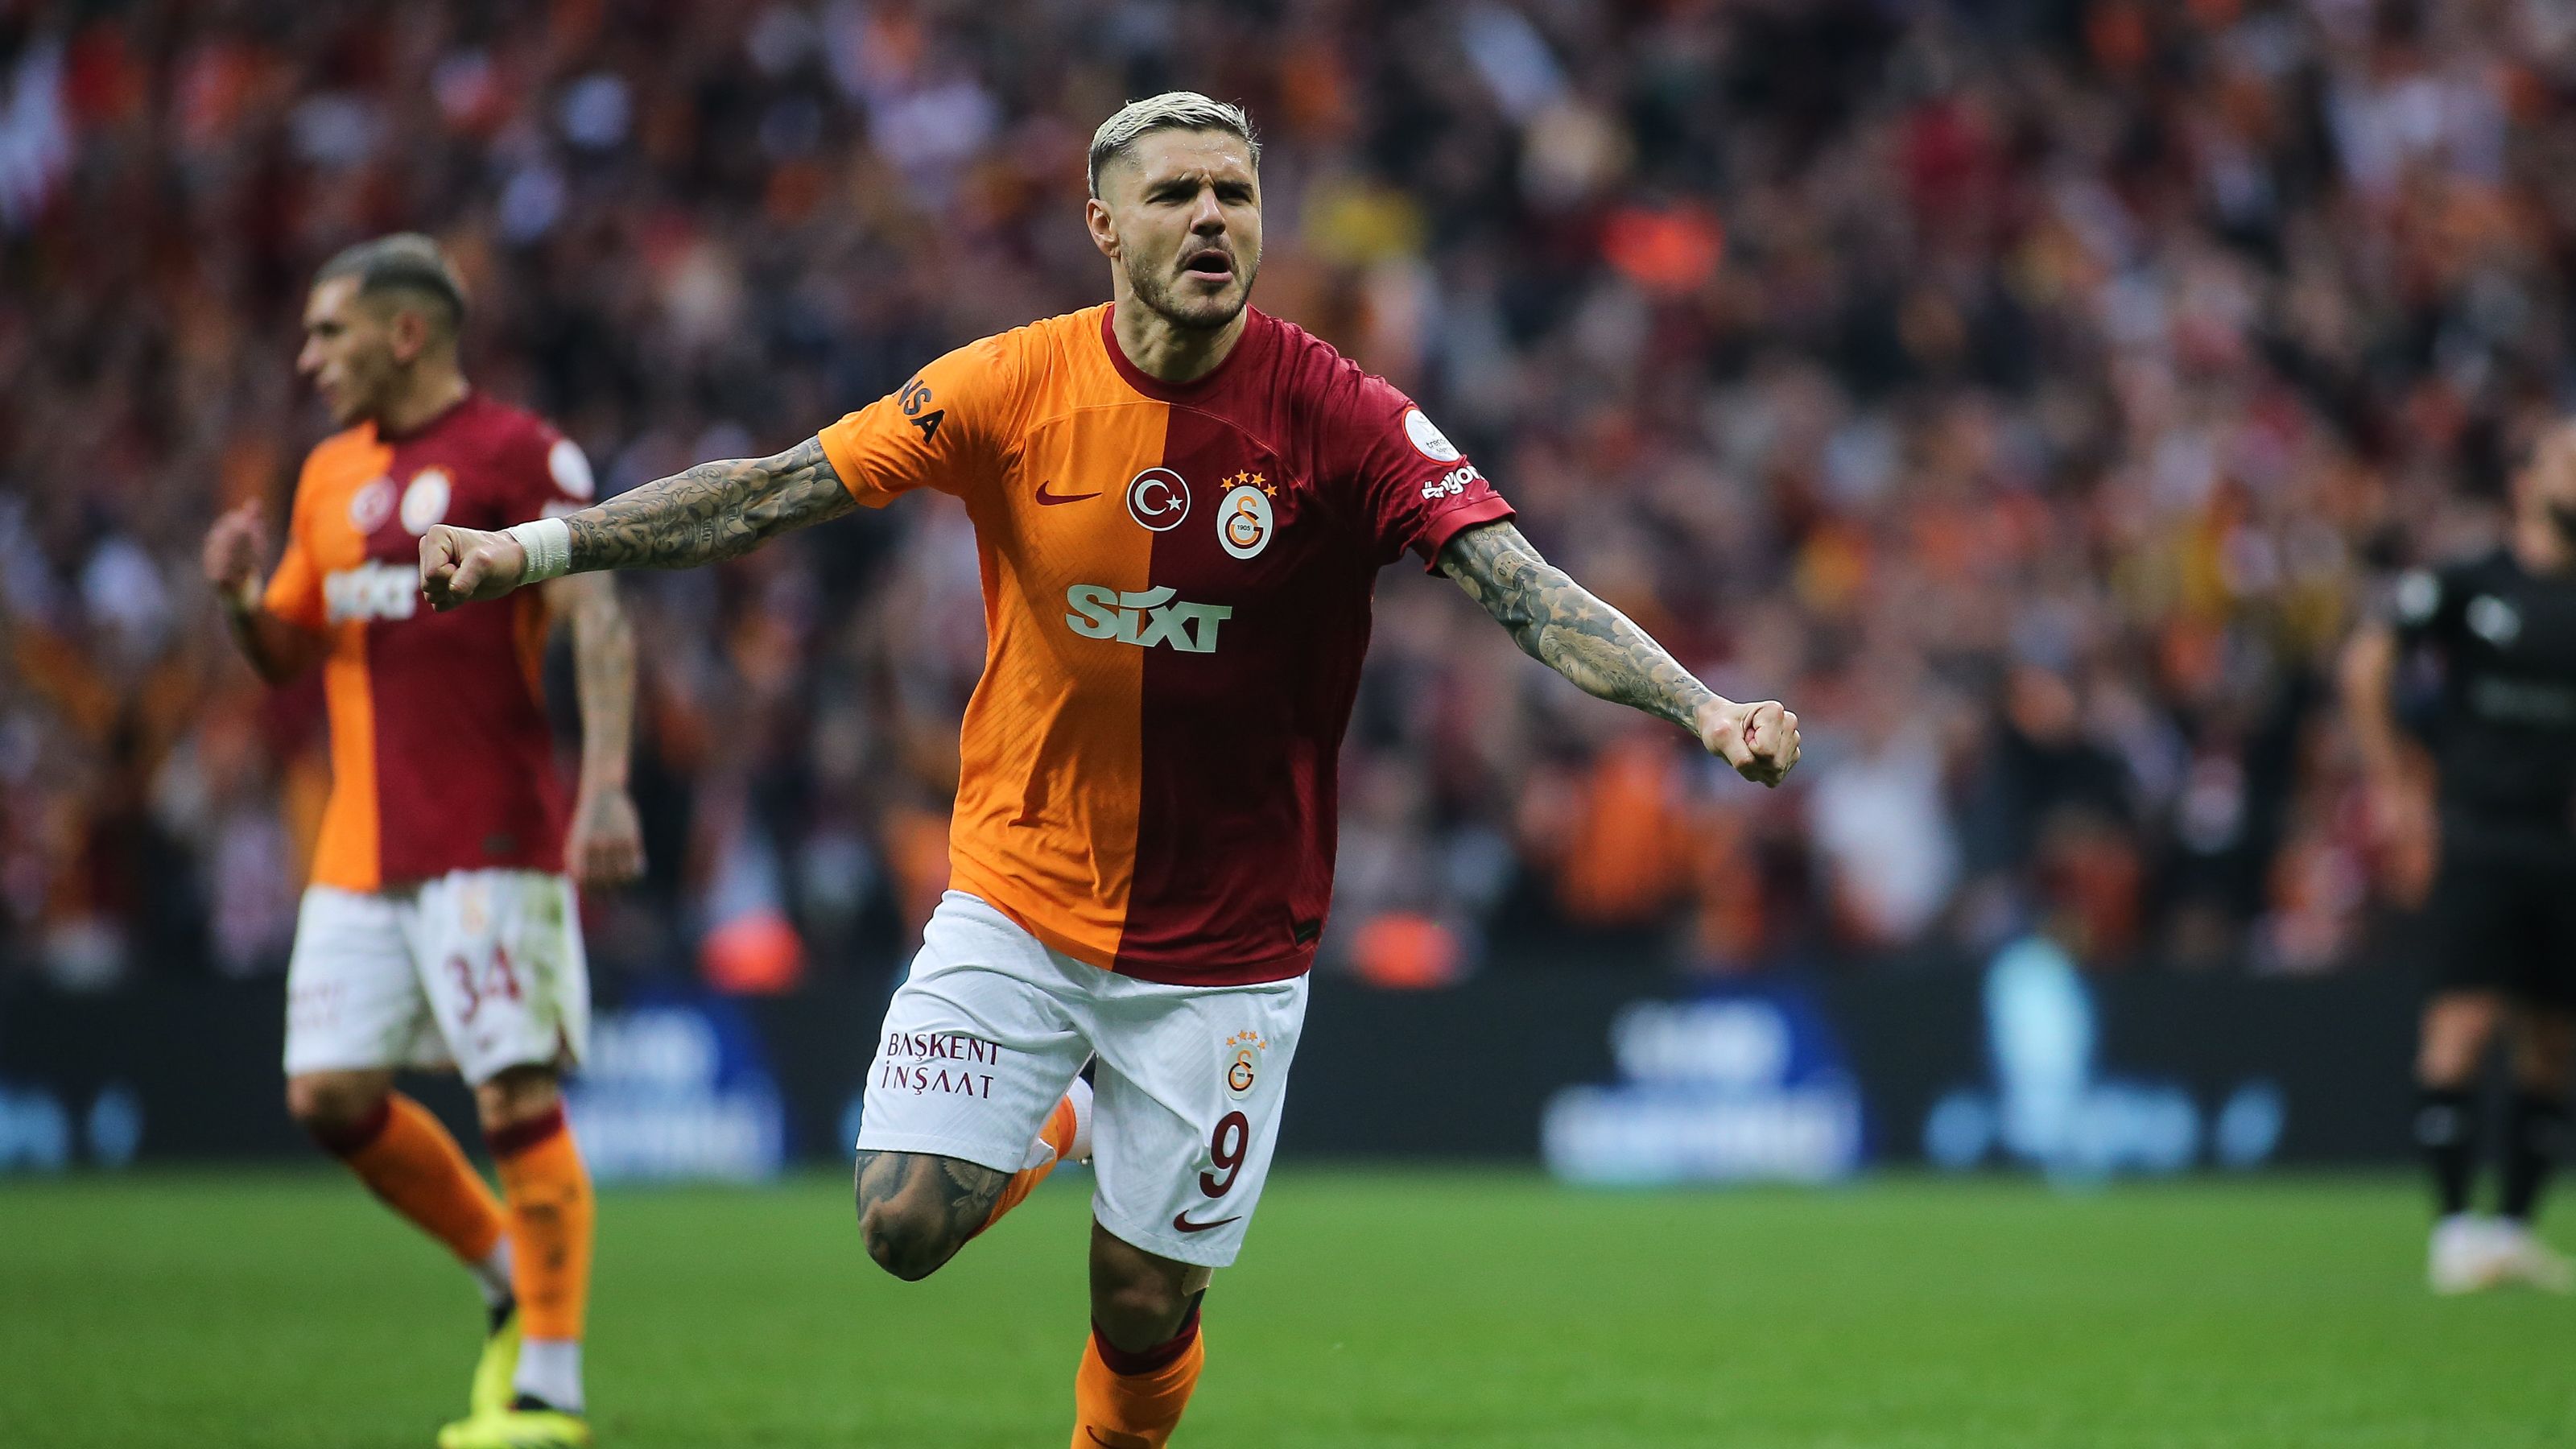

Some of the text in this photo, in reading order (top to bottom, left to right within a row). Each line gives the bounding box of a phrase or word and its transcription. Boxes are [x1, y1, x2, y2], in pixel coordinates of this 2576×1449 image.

[442, 943, 522, 1026] 34
[881, 1060, 994, 1099] İNŞAAT
[887, 1033, 1002, 1065] BAŞKENT
[1199, 1111, 1249, 1199] 9
